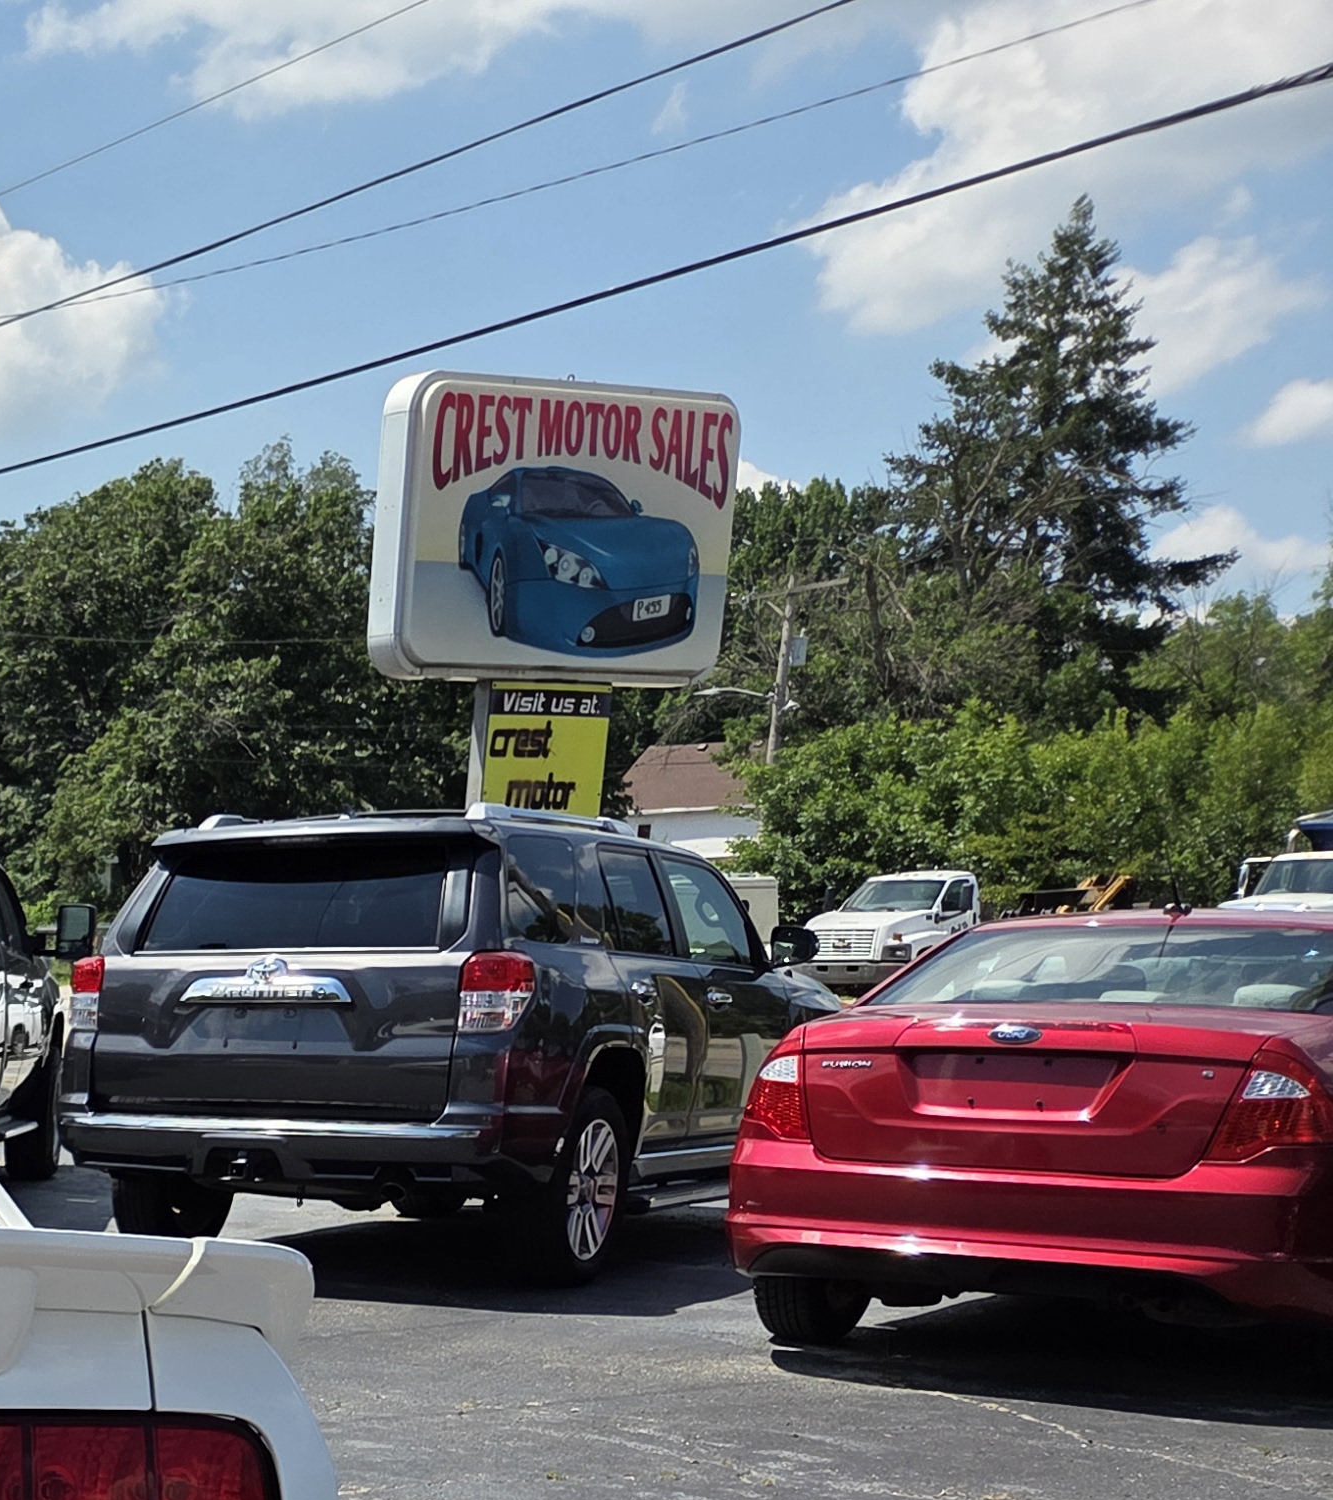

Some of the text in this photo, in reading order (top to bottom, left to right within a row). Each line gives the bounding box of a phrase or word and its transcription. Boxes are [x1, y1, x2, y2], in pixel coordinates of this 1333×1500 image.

[433, 391, 733, 510] CREST MOTOR SALES
[503, 692, 546, 712] Visit
[550, 698, 575, 713] us
[489, 720, 552, 759] crest
[504, 772, 576, 810] motor
